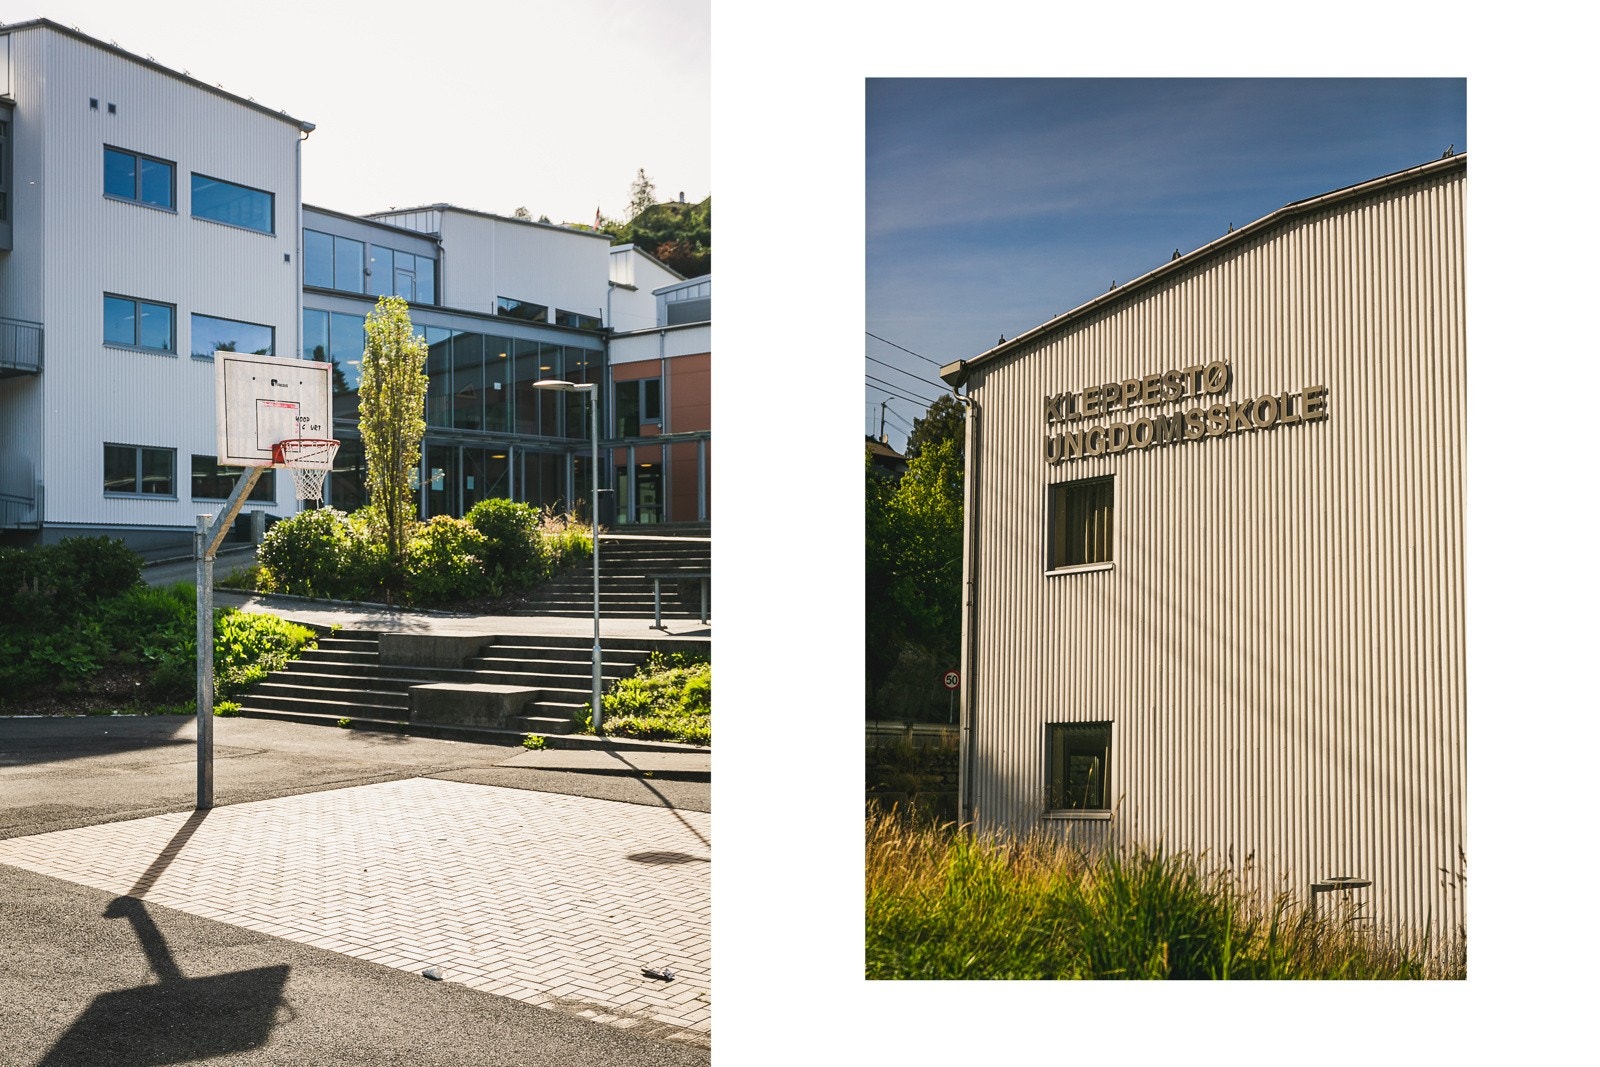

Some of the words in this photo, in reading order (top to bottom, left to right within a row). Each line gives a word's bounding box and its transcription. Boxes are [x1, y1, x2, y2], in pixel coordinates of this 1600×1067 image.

[1043, 358, 1231, 425] KLEPPESTØ
[1043, 384, 1327, 465] UNGDOMSSKOLE
[946, 675, 958, 685] 50
